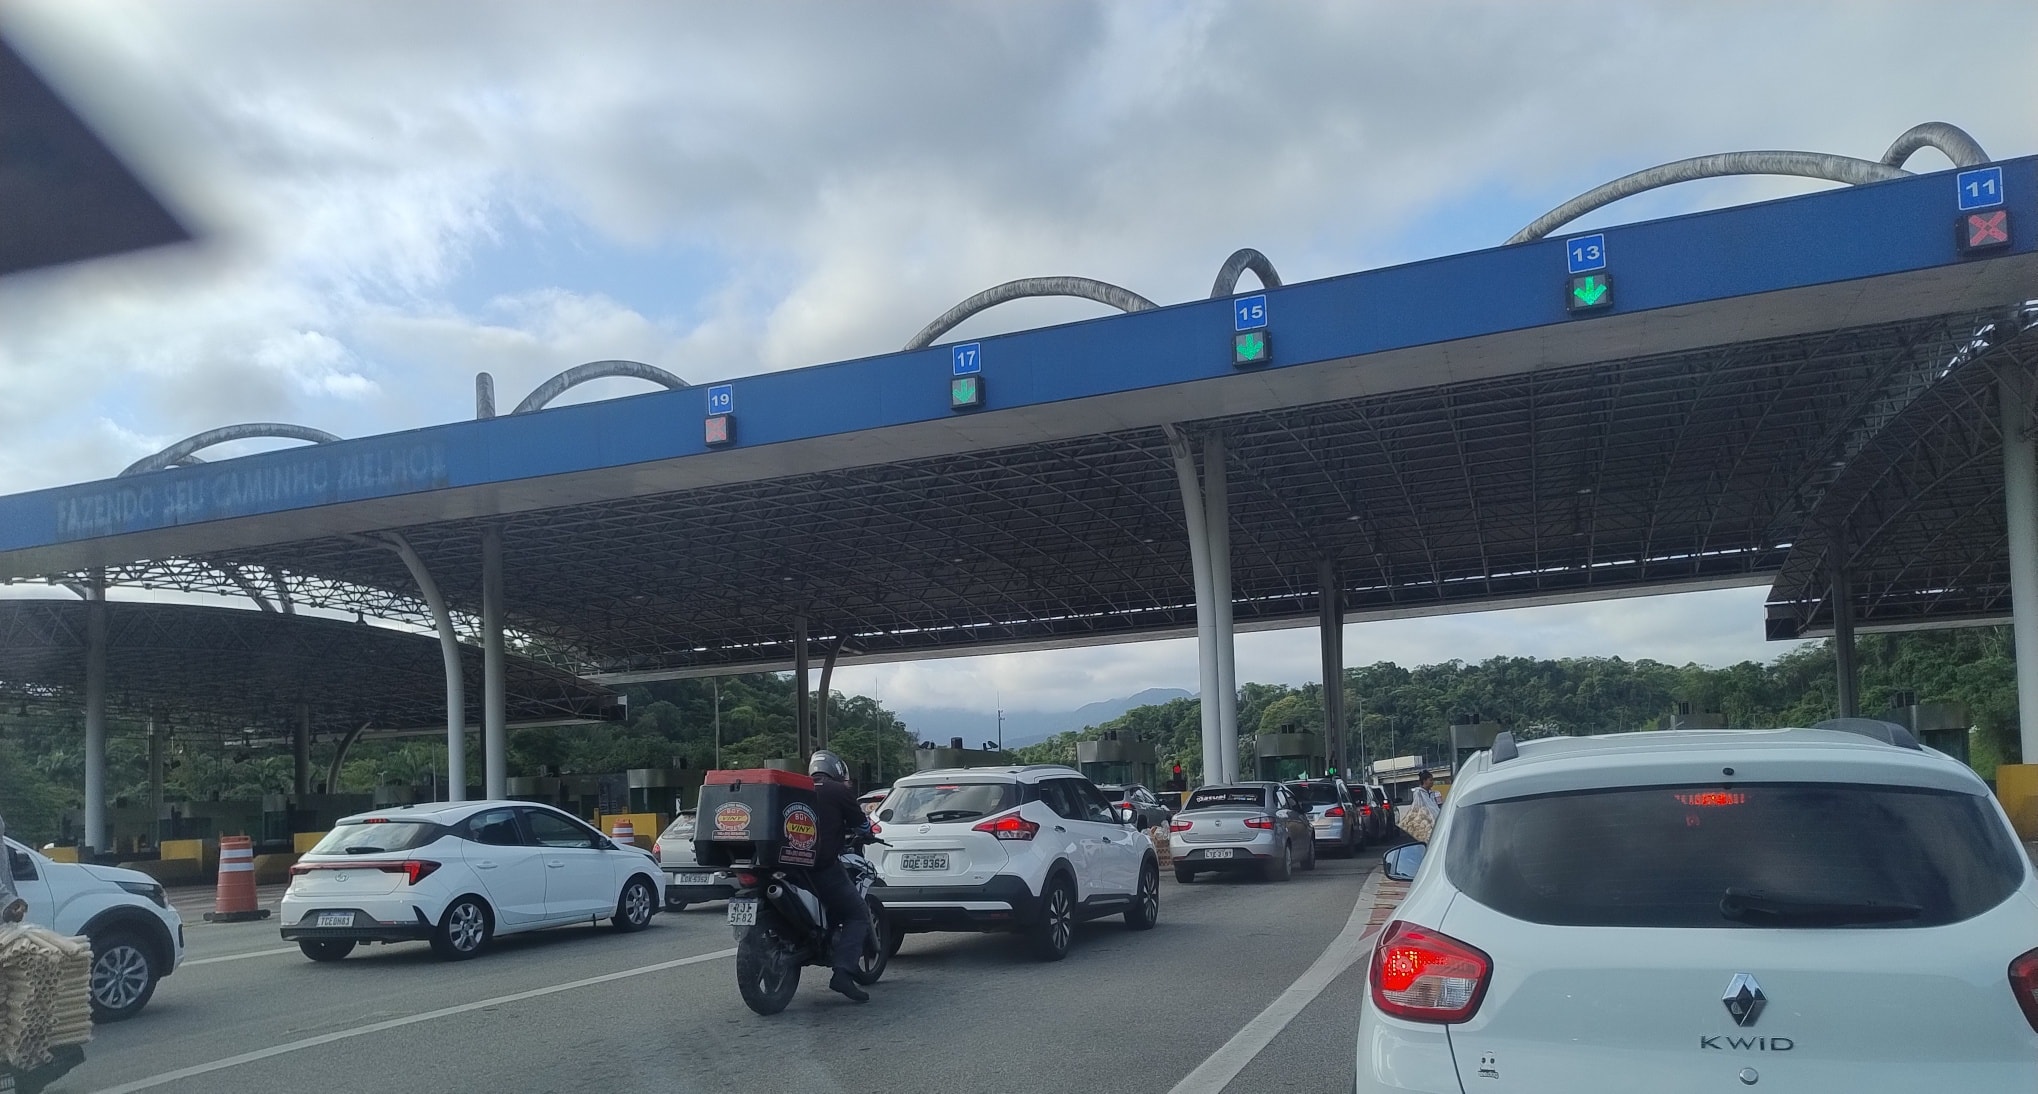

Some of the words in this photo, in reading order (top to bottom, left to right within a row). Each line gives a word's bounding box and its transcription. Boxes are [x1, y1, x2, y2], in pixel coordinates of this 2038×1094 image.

[1966, 179, 1995, 197] 11
[1572, 245, 1601, 262] 13
[1239, 305, 1264, 320] 15
[956, 350, 976, 367] 17
[711, 392, 730, 408] 19
[794, 813, 808, 822] BOY
[791, 824, 811, 833] VINY
[731, 913, 753, 923] 5F82
[1700, 1035, 1794, 1051] KWID
